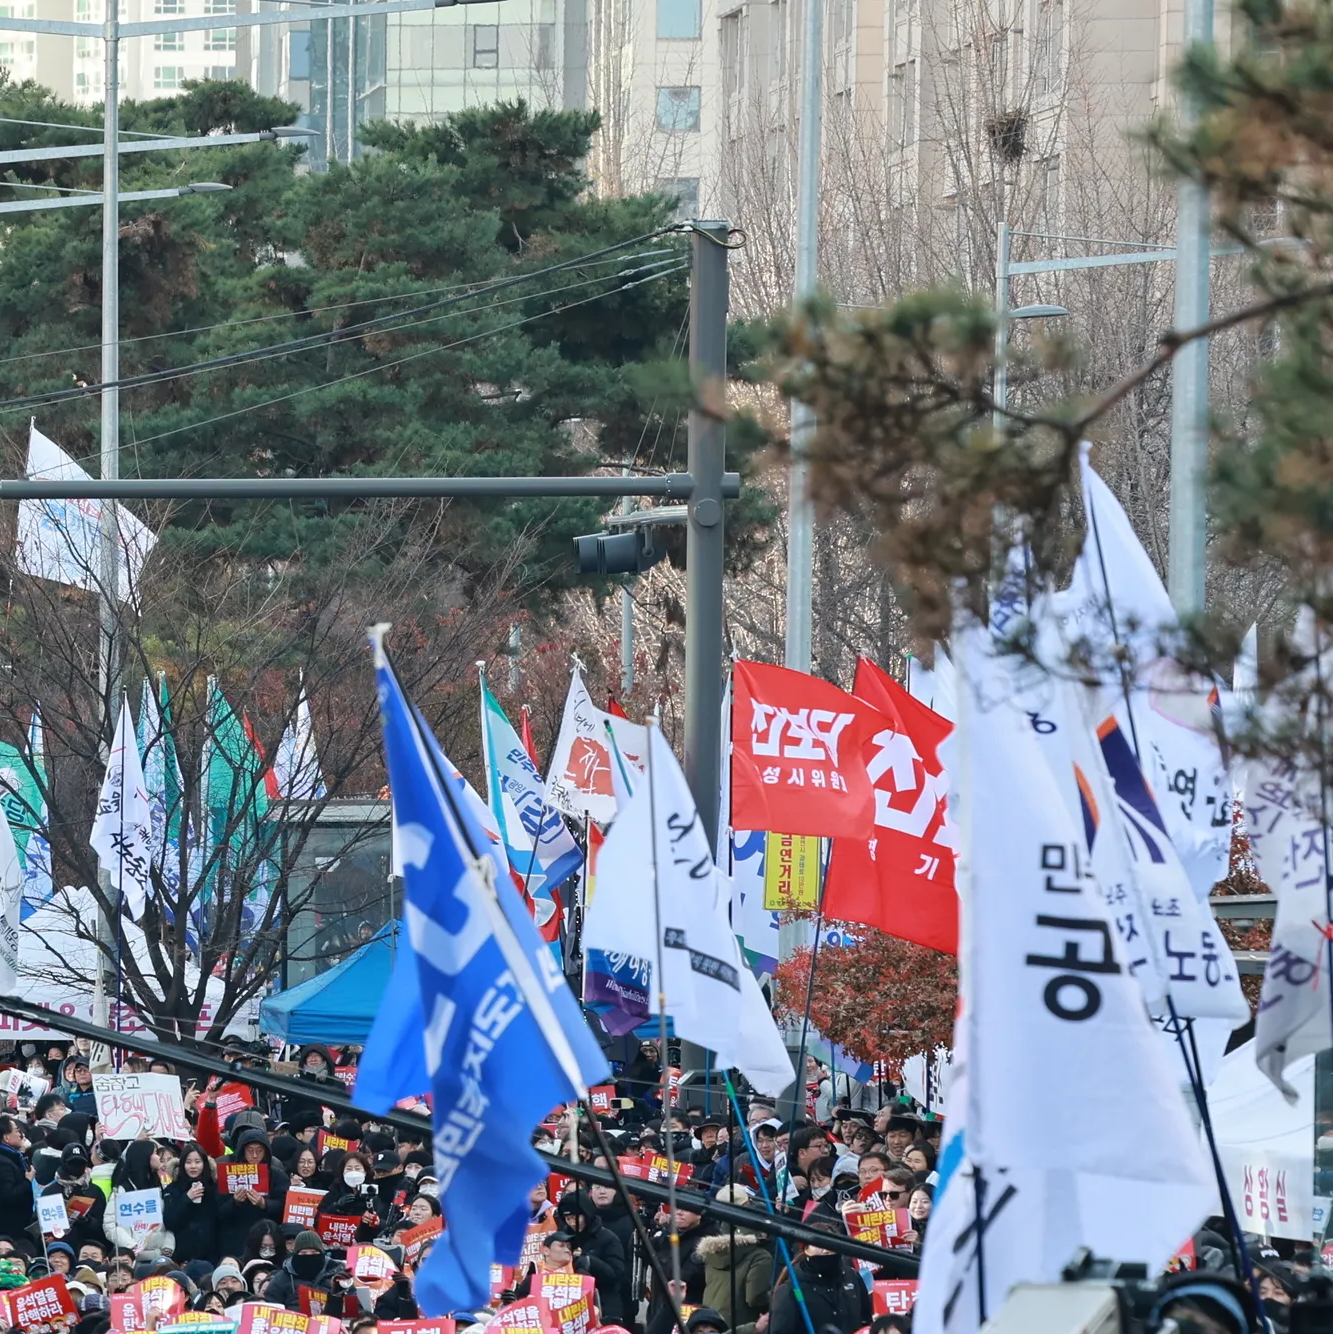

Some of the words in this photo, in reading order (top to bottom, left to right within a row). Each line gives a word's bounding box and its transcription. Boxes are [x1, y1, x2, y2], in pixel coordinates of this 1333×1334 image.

[226, 1164, 260, 1176] 내란죄
[120, 1199, 158, 1215] 연수을
[16, 1287, 58, 1309] 윤석열을
[18, 1301, 64, 1324] 탄핵하라
